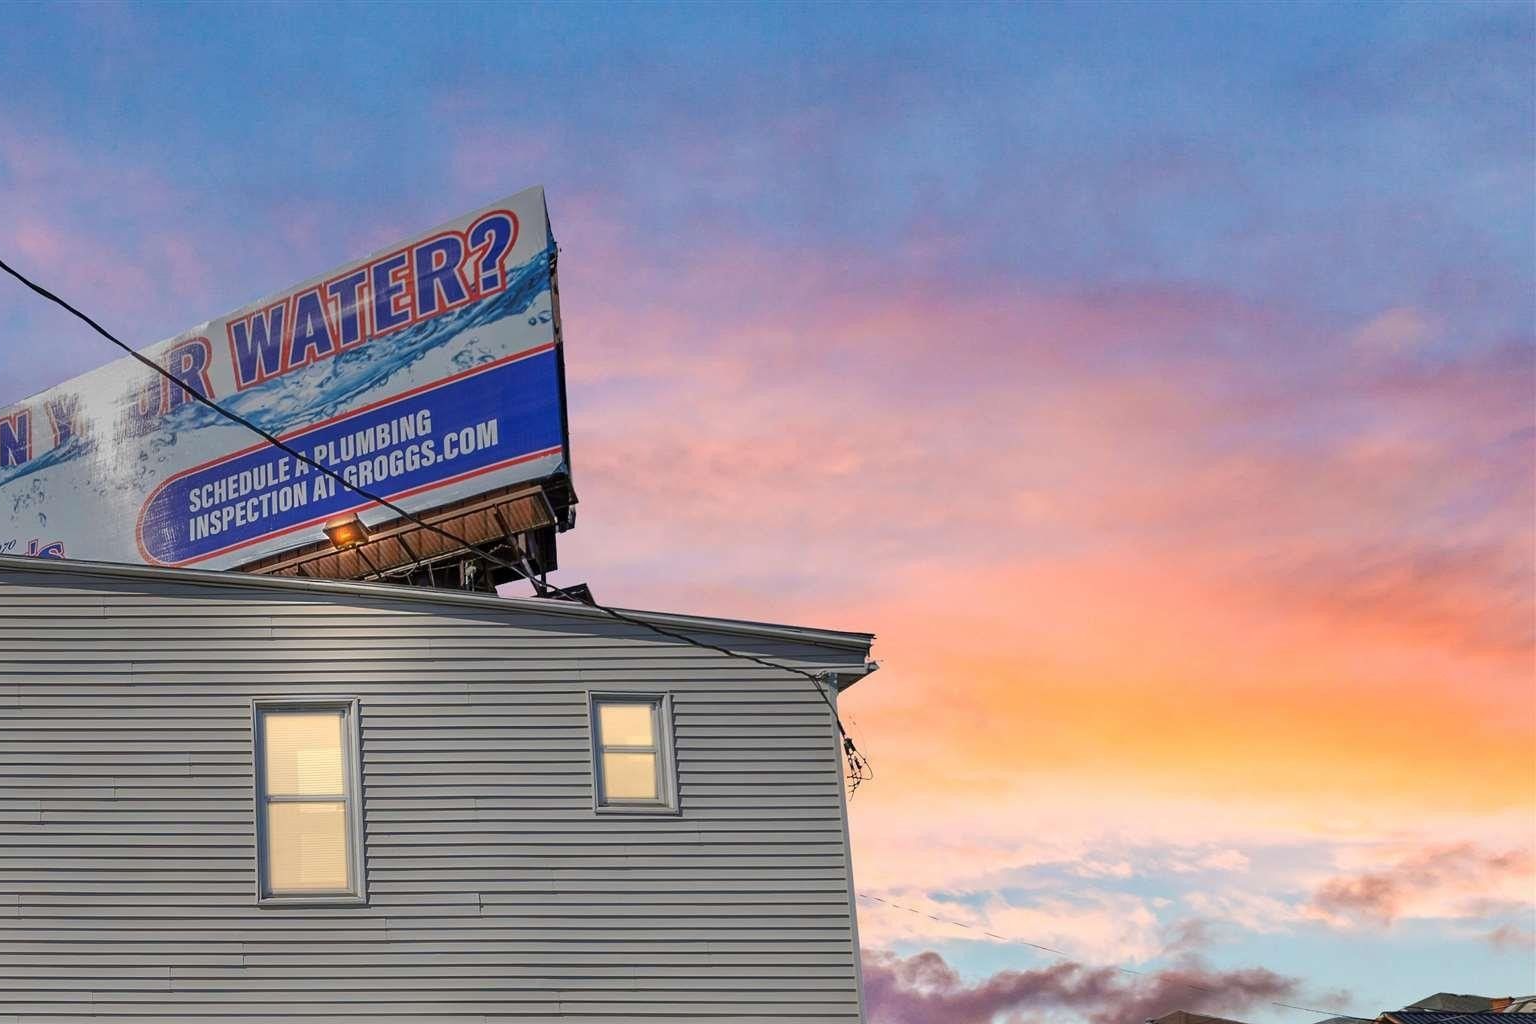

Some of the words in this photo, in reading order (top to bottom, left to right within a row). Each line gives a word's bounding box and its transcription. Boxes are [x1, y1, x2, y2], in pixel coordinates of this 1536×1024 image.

[226, 209, 519, 392] WATER?
[188, 456, 290, 513] SCHEDULE
[295, 451, 309, 477] A
[314, 408, 432, 469] PLUMBING
[189, 480, 308, 542] INSPECTION
[312, 472, 339, 504] AT
[343, 418, 499, 492] GROGGS.COM
